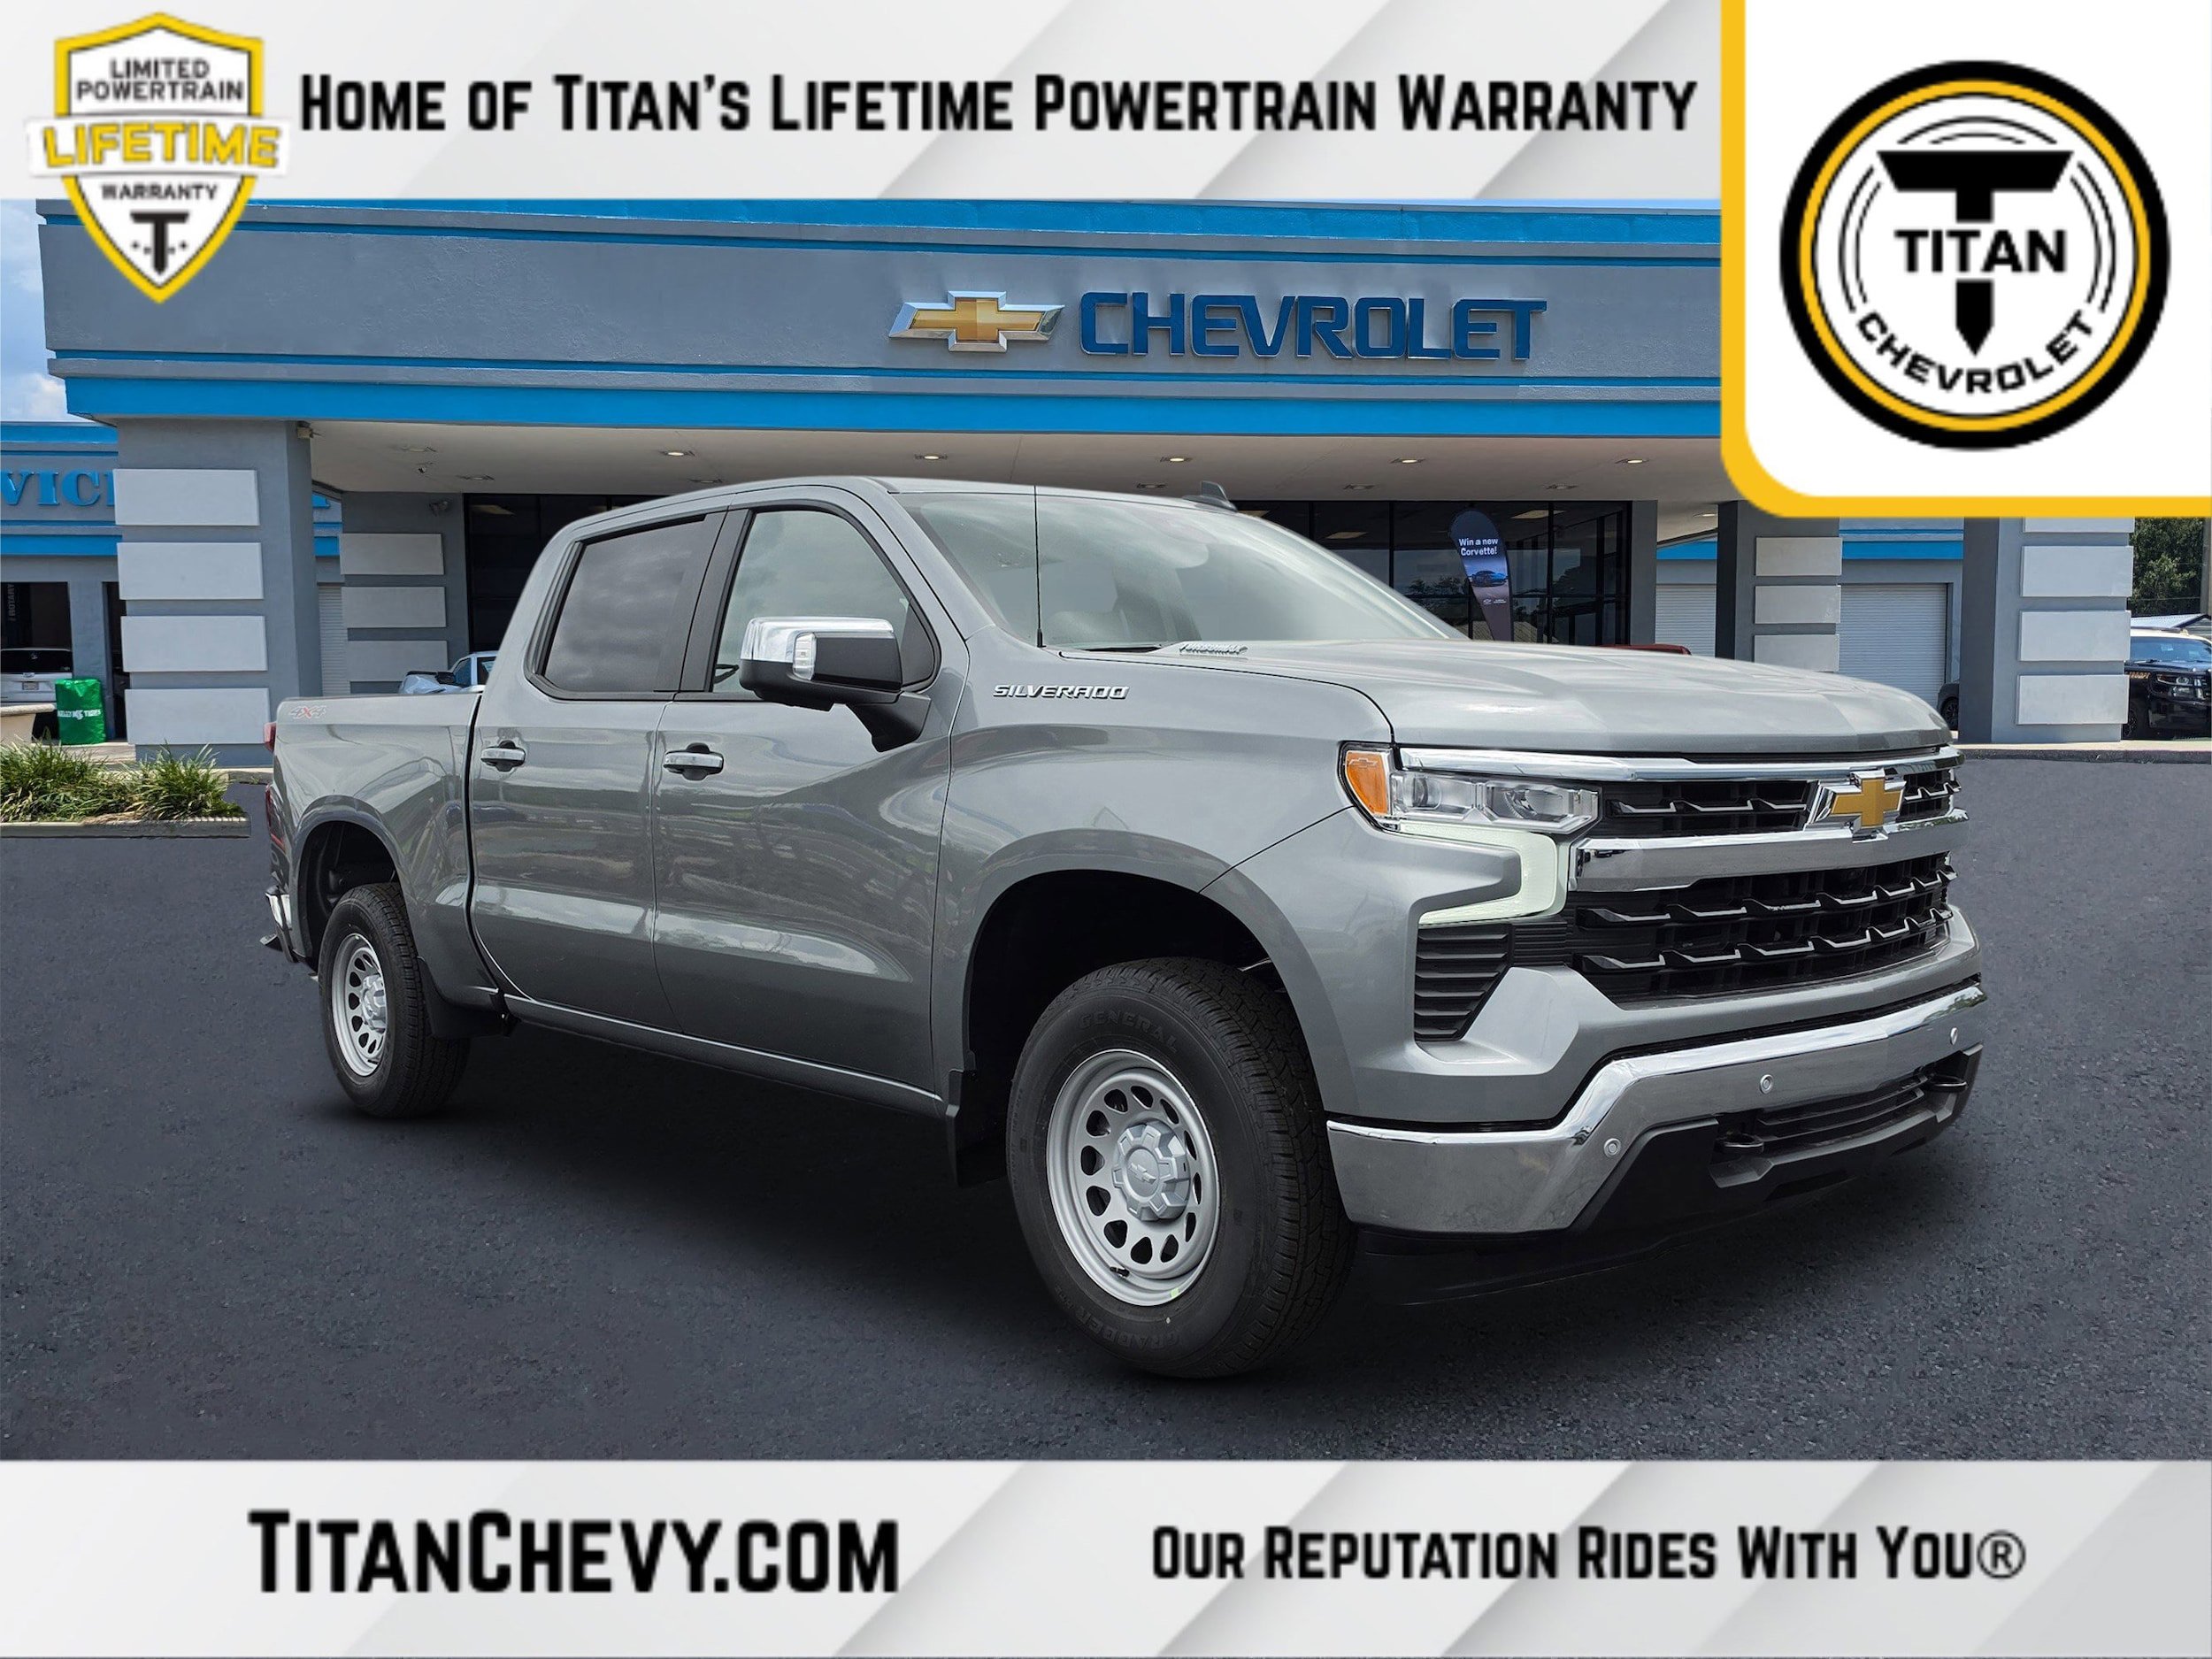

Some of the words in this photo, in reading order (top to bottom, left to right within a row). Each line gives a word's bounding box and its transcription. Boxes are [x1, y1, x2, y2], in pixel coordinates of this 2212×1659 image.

[1080, 291, 1548, 361] CHEVROLET
[0, 469, 116, 507] VIC
[1460, 547, 1498, 556] Corvette!
[993, 684, 1130, 700] SILVERADO
[1078, 1009, 1179, 1055] GENERAL
